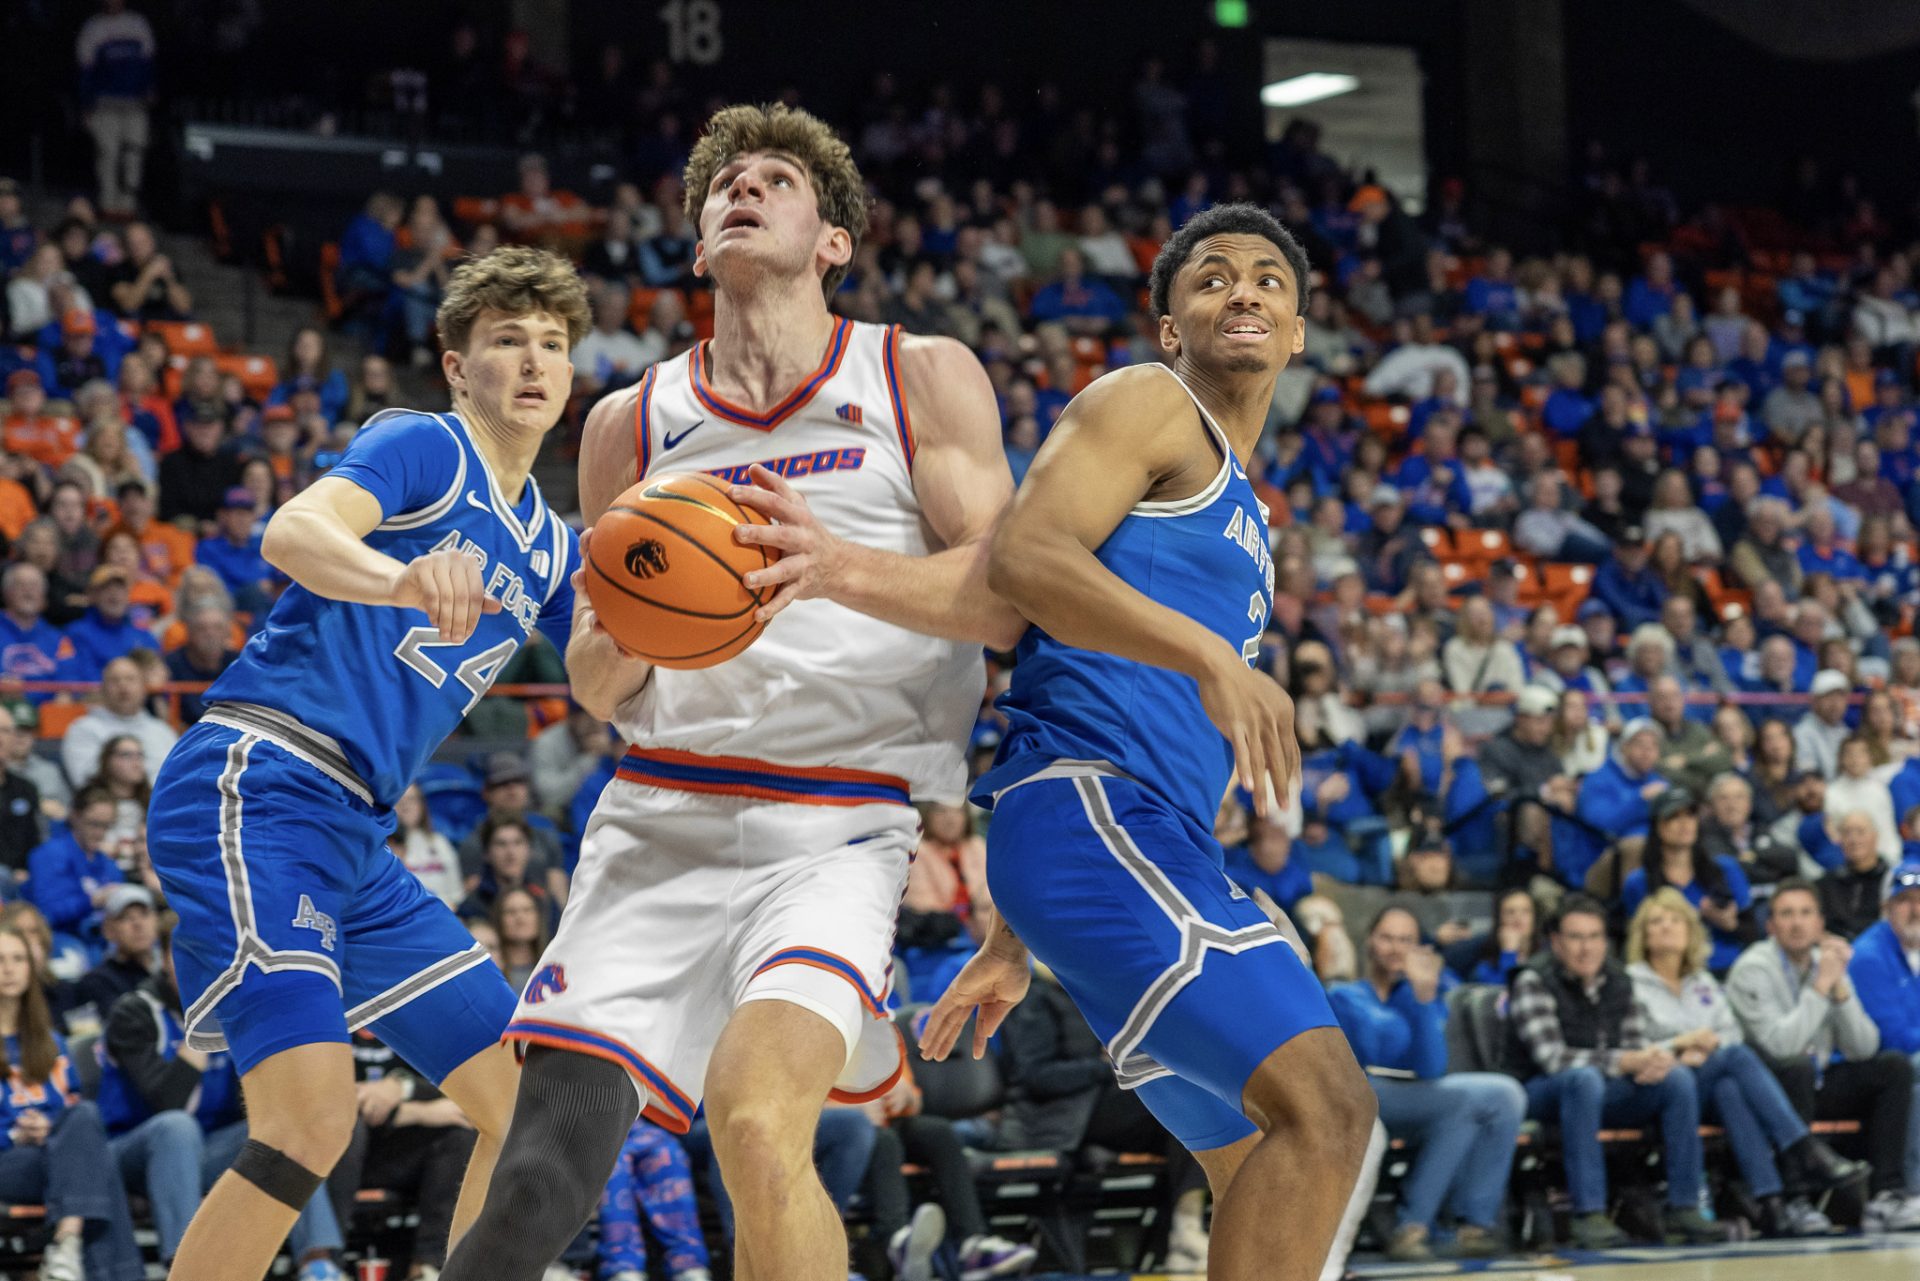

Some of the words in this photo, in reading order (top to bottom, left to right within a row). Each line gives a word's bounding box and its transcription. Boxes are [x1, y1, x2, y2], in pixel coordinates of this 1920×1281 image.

[659, 0, 722, 63] 18
[702, 447, 867, 486] RONCOS
[1222, 505, 1260, 565] AIR
[393, 626, 519, 718] 24
